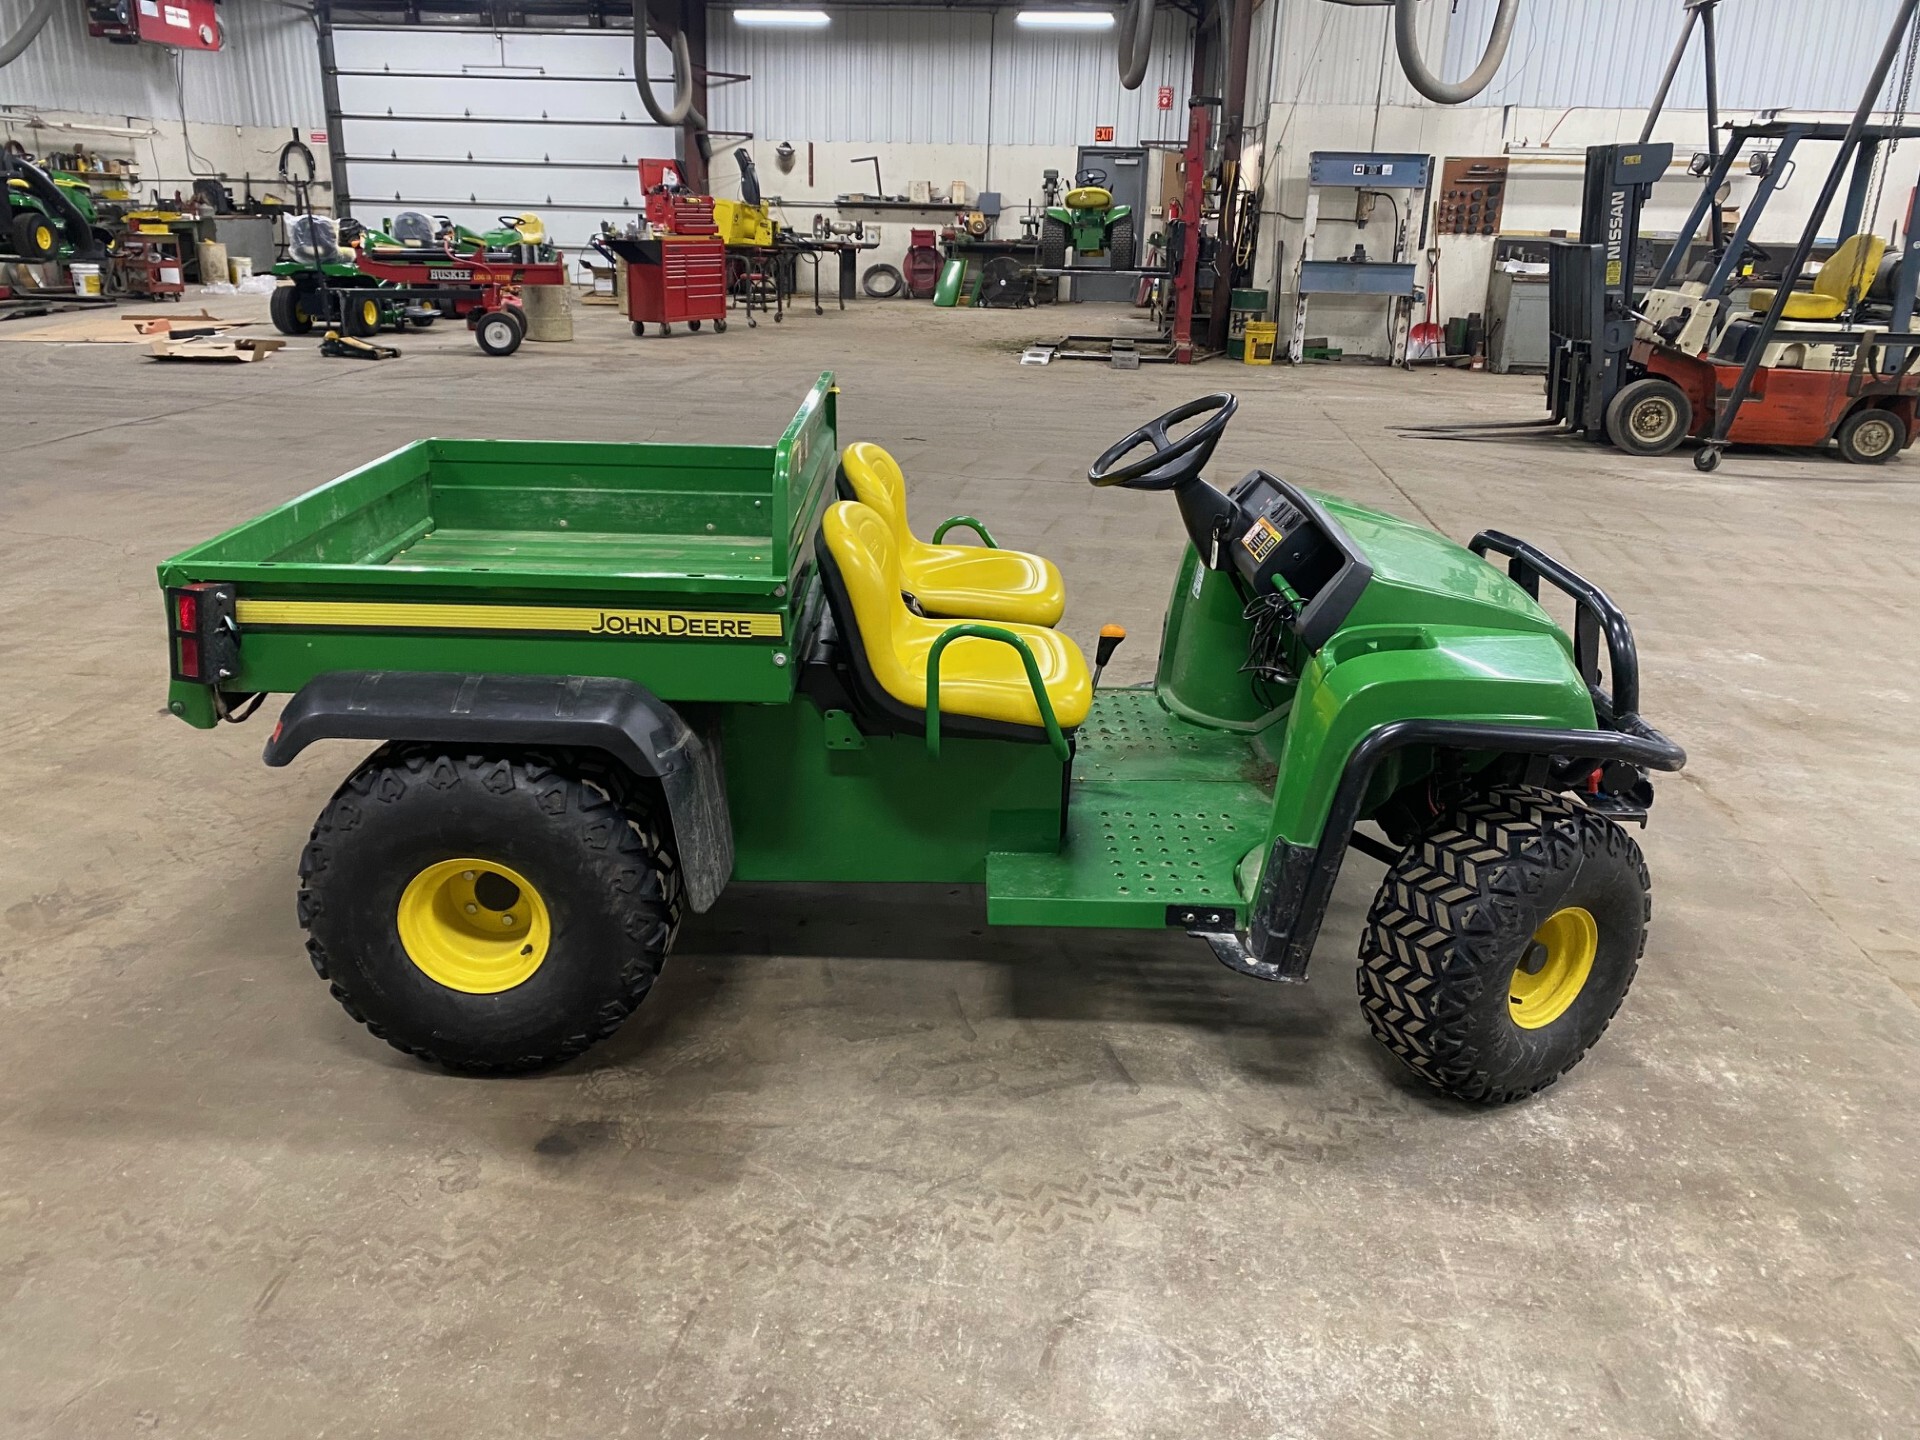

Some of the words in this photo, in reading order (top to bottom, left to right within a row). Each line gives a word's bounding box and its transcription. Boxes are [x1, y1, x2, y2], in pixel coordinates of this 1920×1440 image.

[1096, 127, 1113, 140] EXIT
[1607, 191, 1625, 260] NISSAN
[430, 269, 471, 280] HUSKEE
[591, 612, 662, 632] JOHN
[667, 614, 752, 636] DEERE
